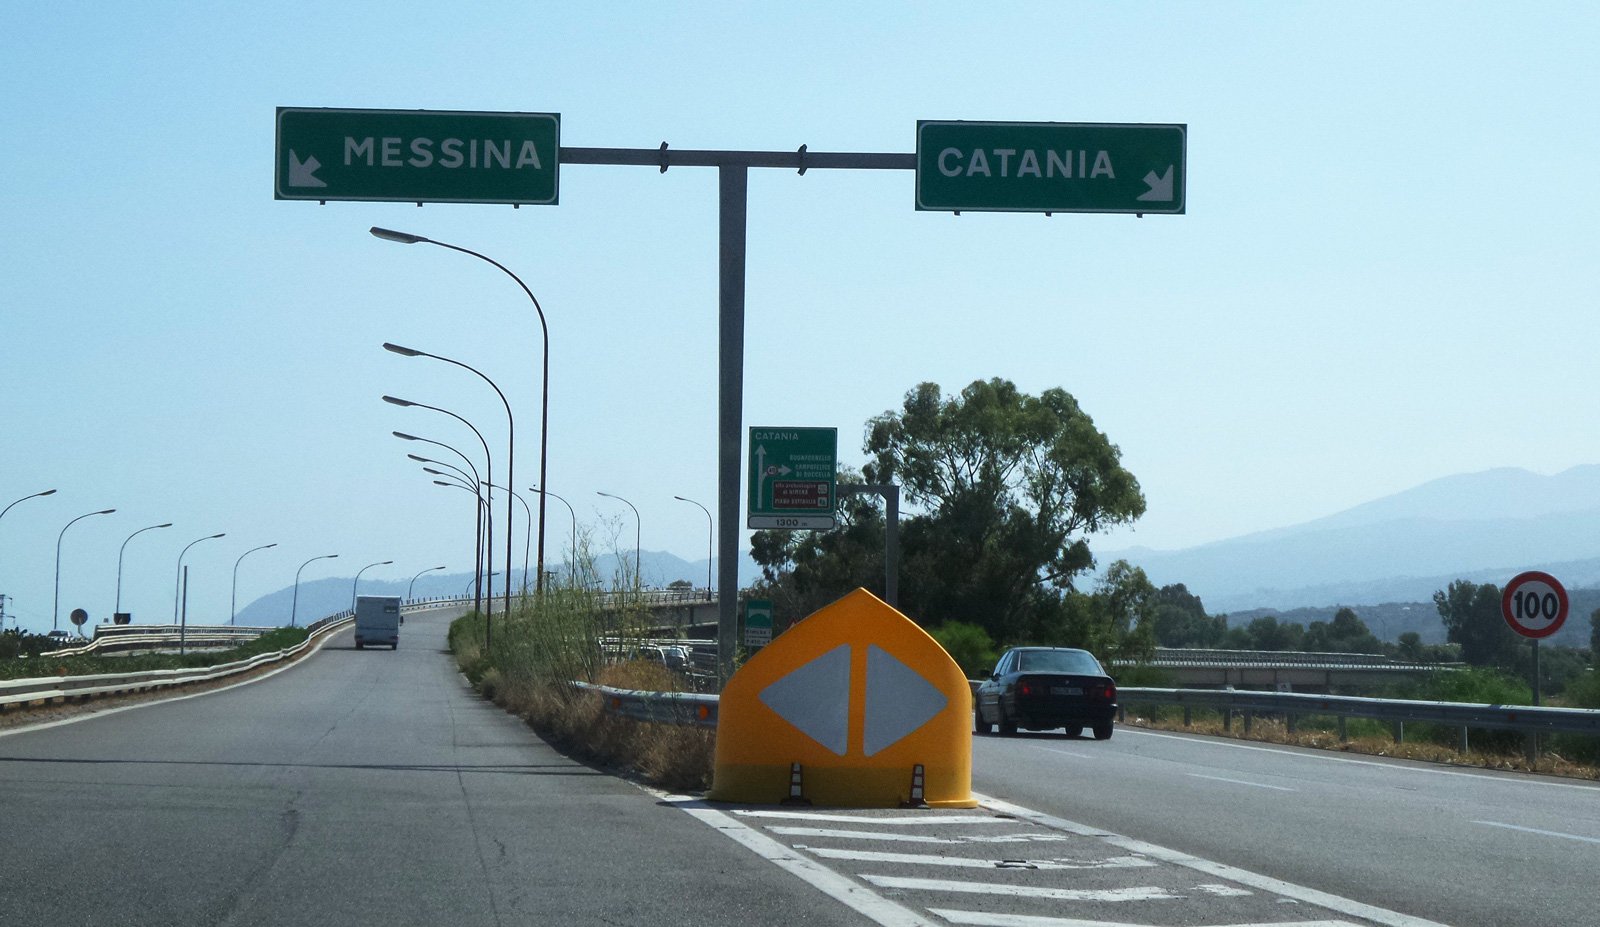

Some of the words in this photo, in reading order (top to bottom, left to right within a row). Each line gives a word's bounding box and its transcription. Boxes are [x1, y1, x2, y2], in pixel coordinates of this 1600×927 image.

[343, 136, 542, 170] MESSINA
[937, 147, 1116, 179] CATANIA
[755, 432, 799, 440] CATANIA
[776, 519, 799, 527] 1300
[1514, 591, 1558, 620] 100
